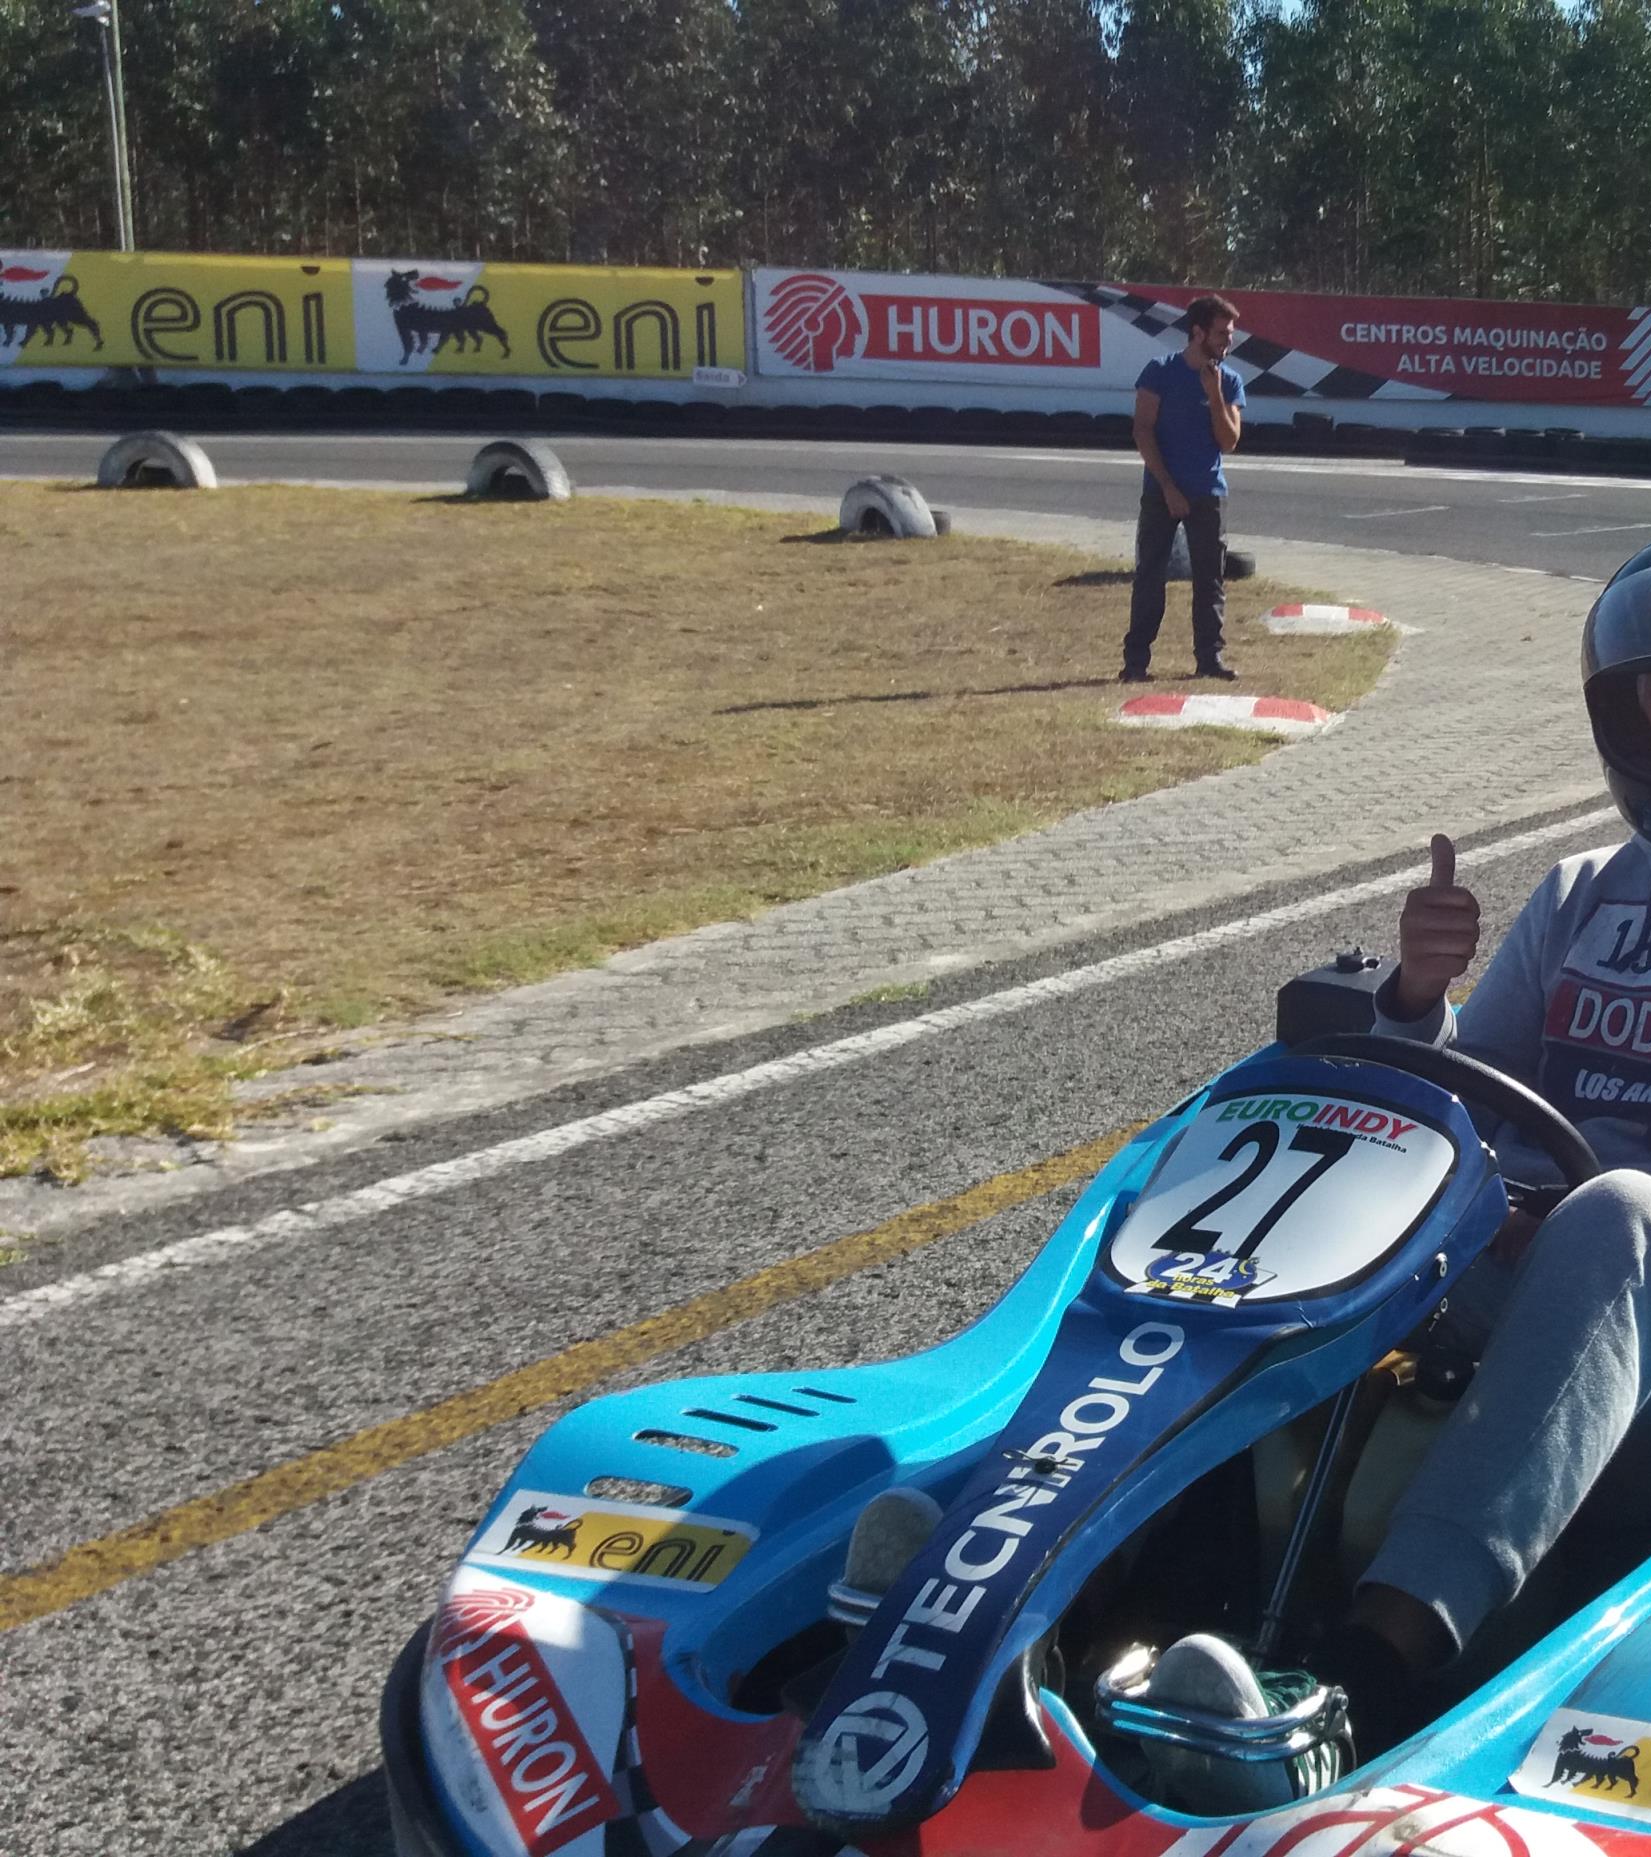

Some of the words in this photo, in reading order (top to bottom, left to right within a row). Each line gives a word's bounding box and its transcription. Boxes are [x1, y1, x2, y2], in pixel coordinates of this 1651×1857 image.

[131, 266, 327, 365] eni
[537, 276, 717, 371] eni
[887, 306, 1081, 360] HURON
[1341, 323, 1447, 345] CENTROS
[1453, 326, 1607, 354] MAQUINAÇÃO
[1396, 353, 1456, 374] ALTA
[1461, 355, 1602, 379] VELOCIDADE
[1575, 1067, 1624, 1100] LOS
[1216, 1099, 1418, 1141] EUROINDY
[1369, 1135, 1407, 1154] Batalha
[1151, 1120, 1356, 1260] 27
[1146, 1279, 1168, 1289] da
[1171, 1281, 1235, 1299] Batalha
[1160, 1252, 1239, 1284] 24
[1172, 1270, 1214, 1286] horas
[871, 1321, 1185, 1680] TECNIROLO
[588, 1529, 731, 1582] eni
[463, 1642, 600, 1838] HURON
